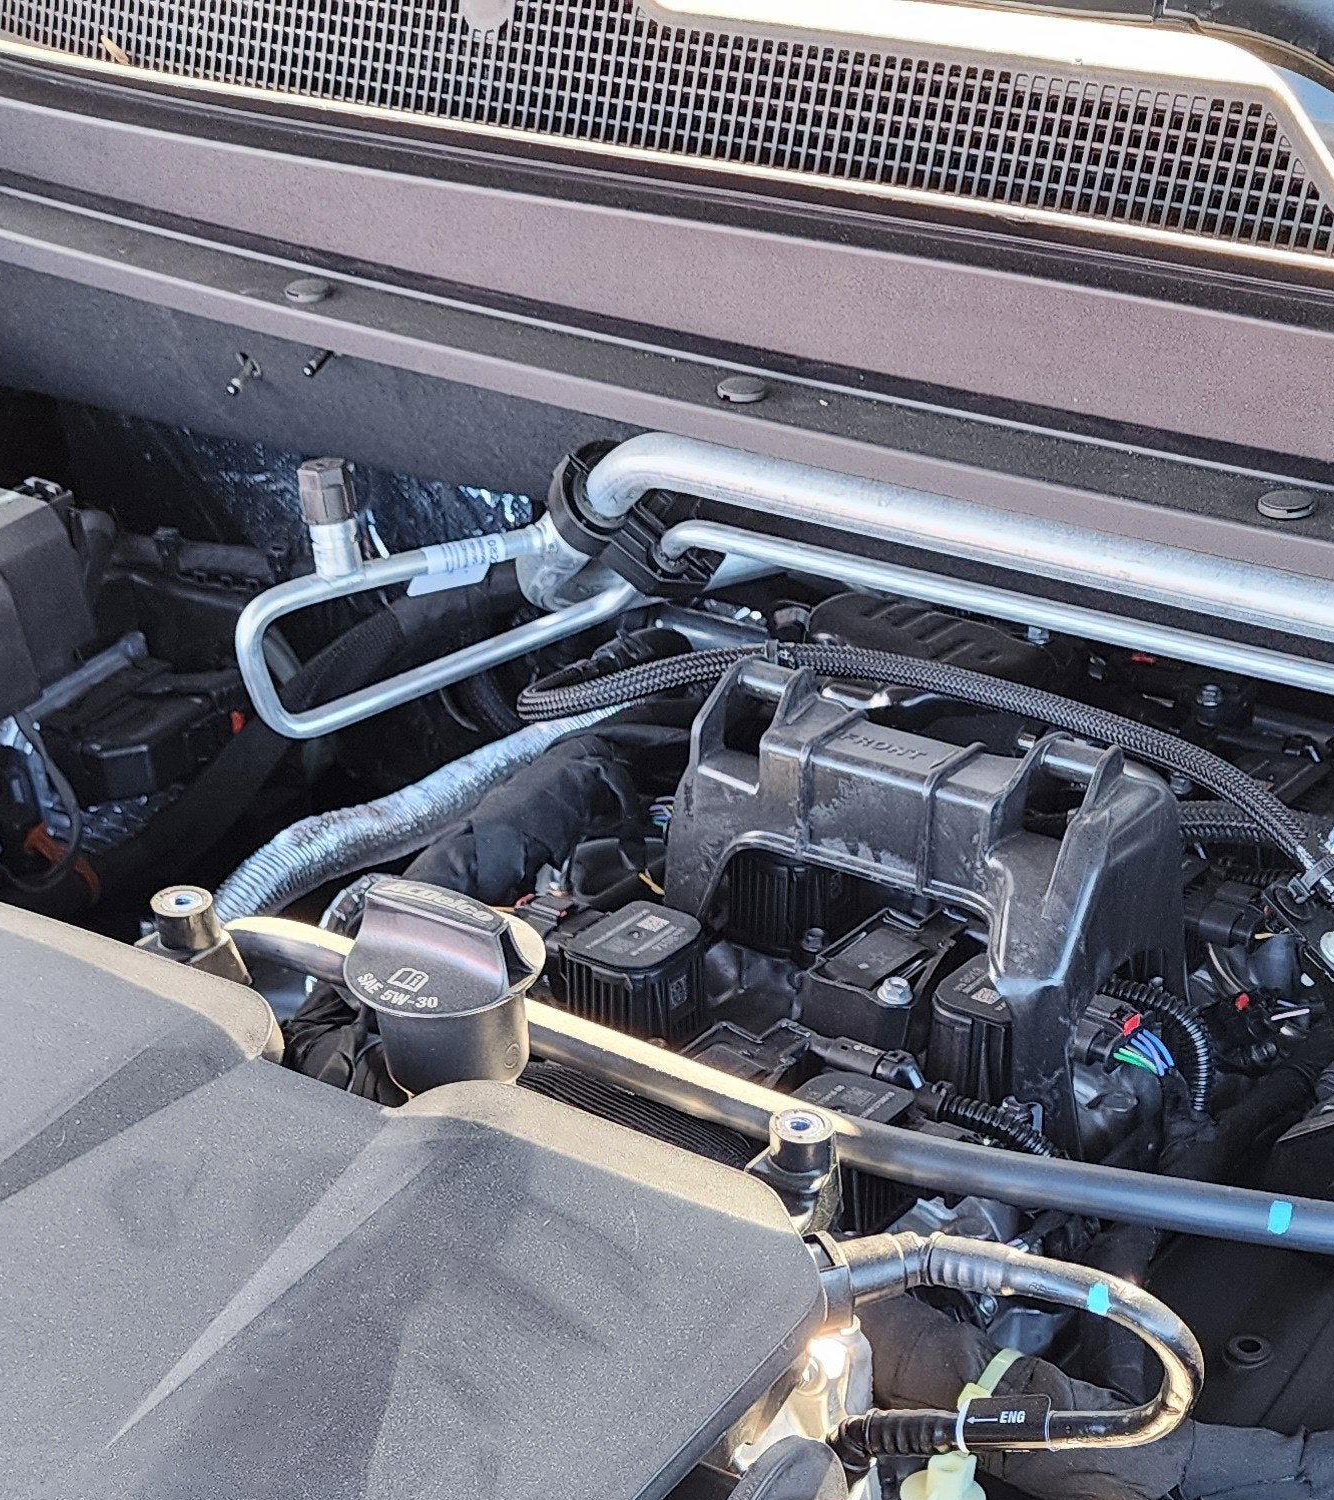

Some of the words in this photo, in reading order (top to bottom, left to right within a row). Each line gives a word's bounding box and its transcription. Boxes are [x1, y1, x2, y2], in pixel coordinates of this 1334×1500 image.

[840, 731, 928, 760] FRONT
[378, 883, 495, 922] ACDelco
[357, 973, 383, 994] SAE
[380, 989, 438, 1009] 5W-30
[999, 1410, 1026, 1424] ENG
